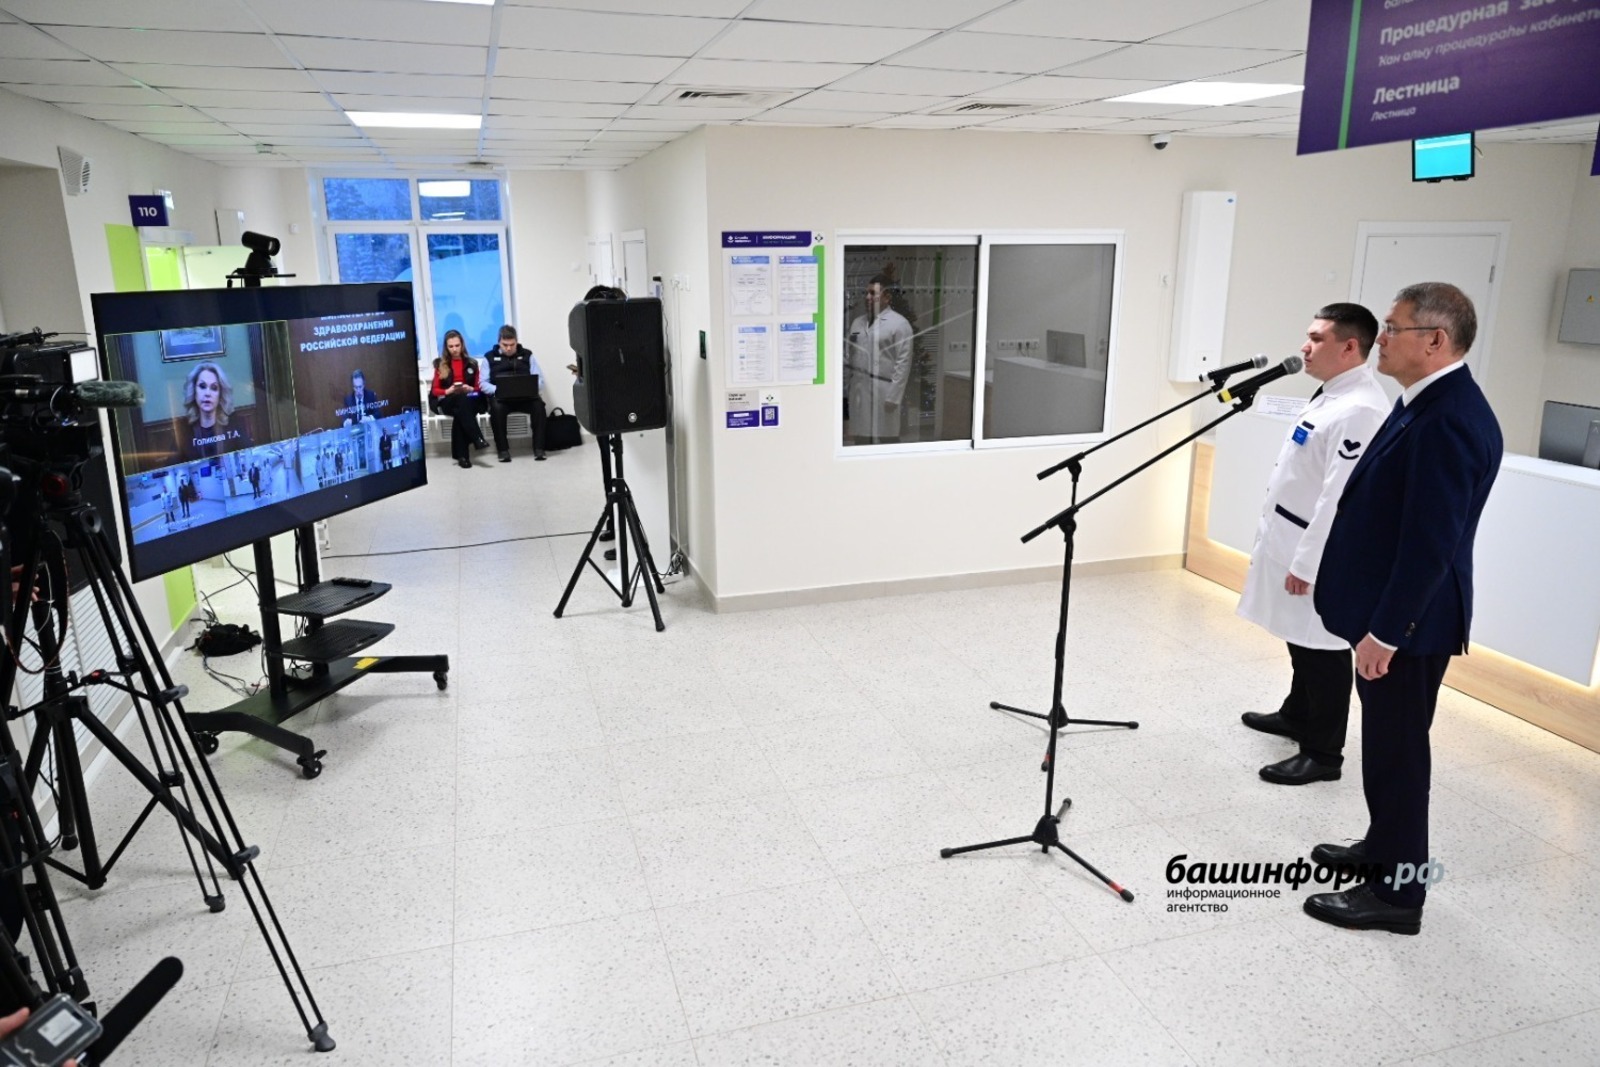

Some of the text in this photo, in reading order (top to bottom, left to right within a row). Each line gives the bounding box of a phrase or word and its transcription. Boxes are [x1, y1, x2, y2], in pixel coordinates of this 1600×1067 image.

[1380, 1, 1509, 46] Процедурная
[1372, 75, 1460, 105] Лестница
[1370, 106, 1417, 122] Лестница
[138, 207, 157, 217] 110
[313, 319, 394, 336] ЗДРАВООХРАНЕНИЯ
[300, 331, 406, 352] РОССИЙСКОЙ ФЕДЕРАЦИИ
[192, 433, 226, 447] Голикова
